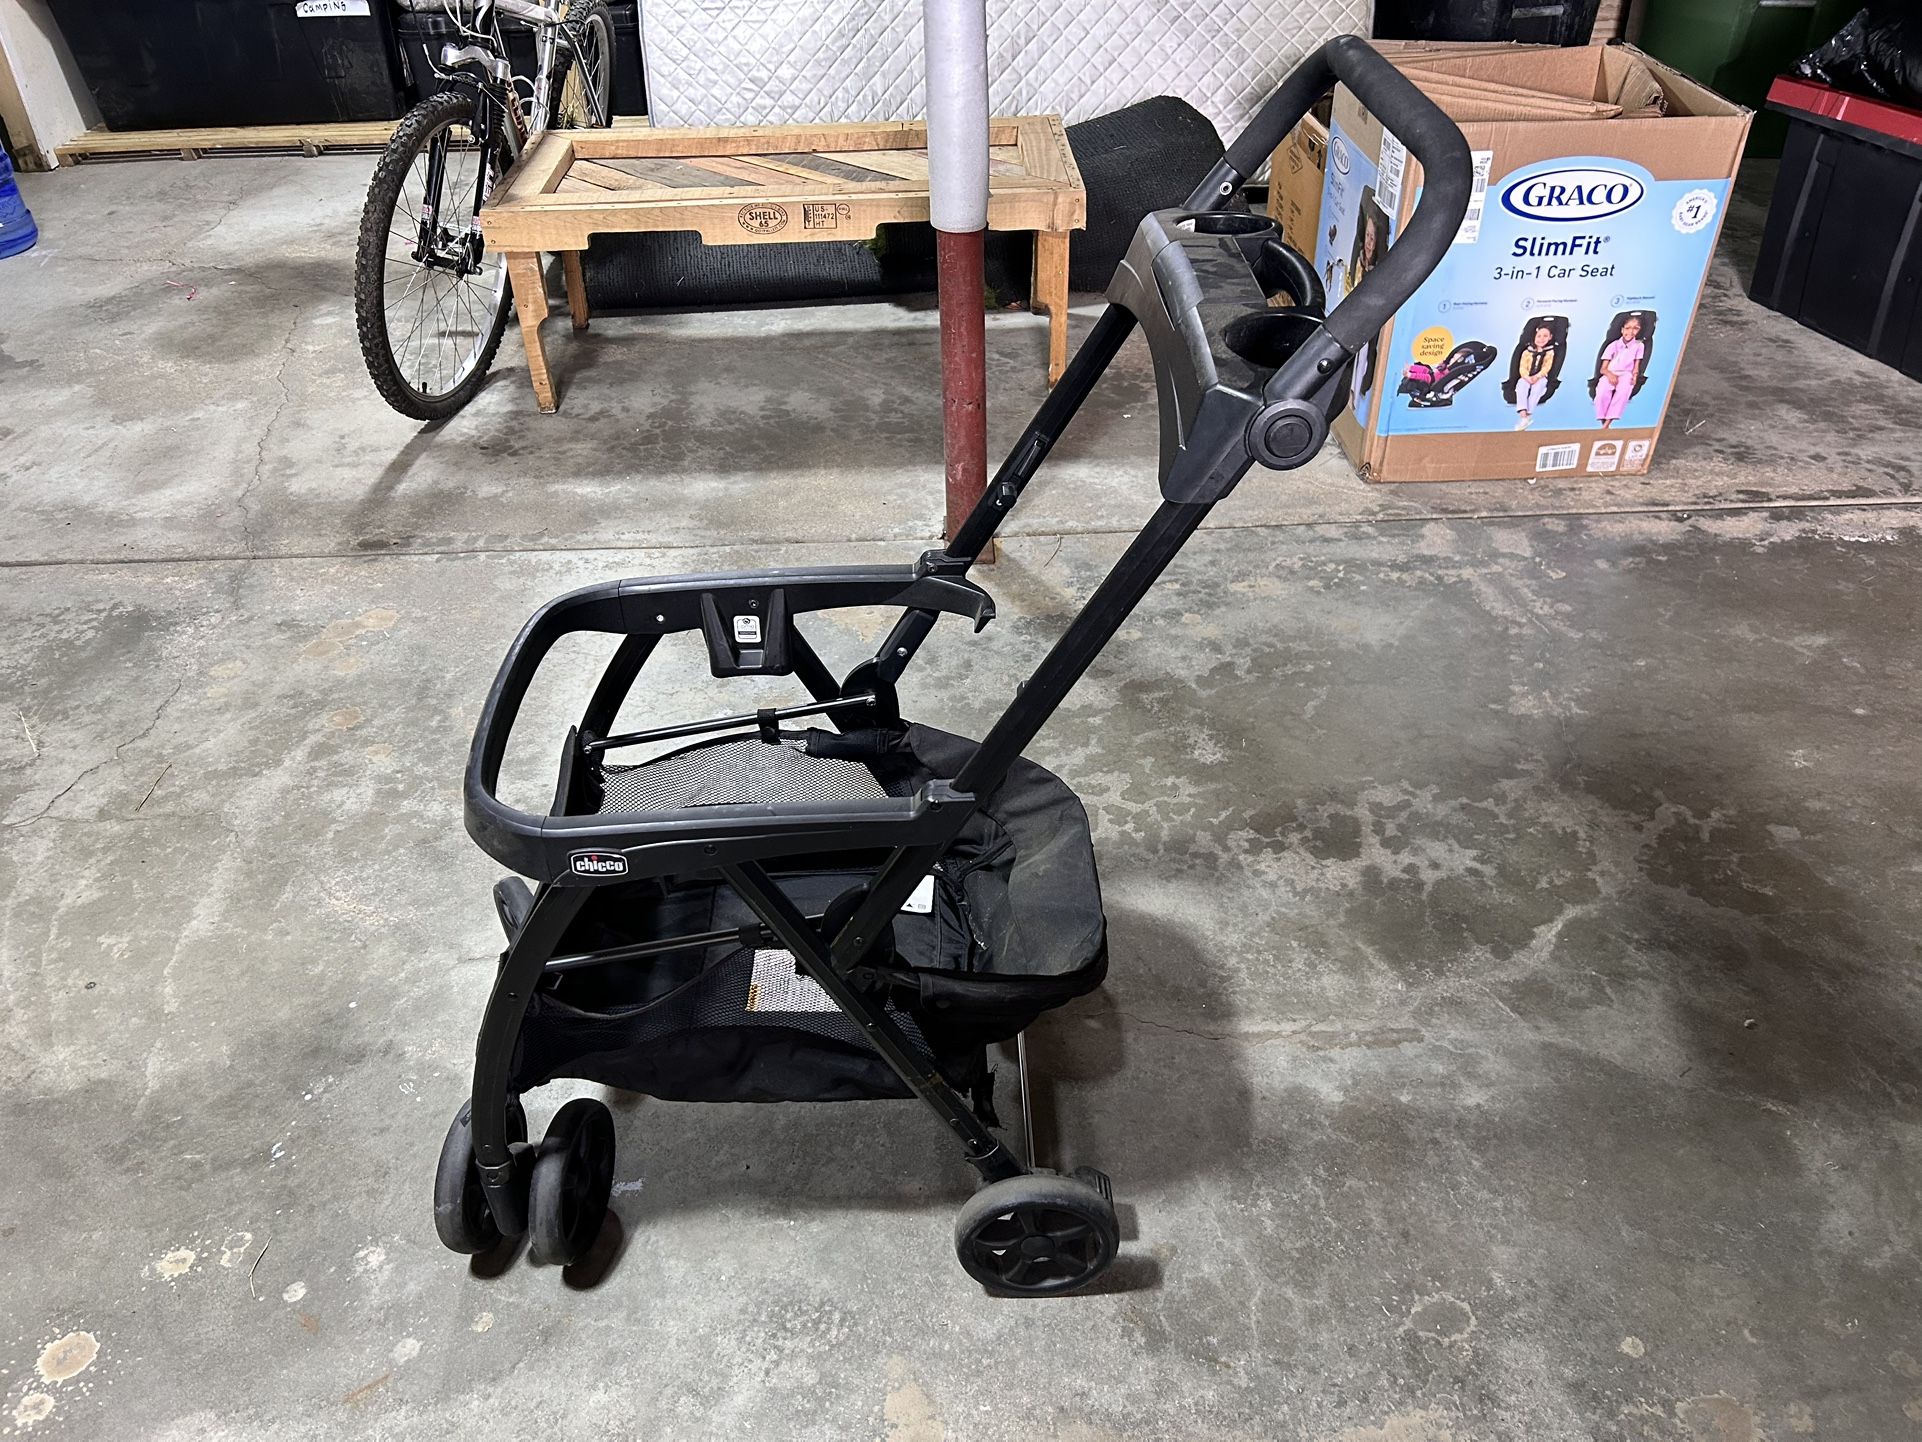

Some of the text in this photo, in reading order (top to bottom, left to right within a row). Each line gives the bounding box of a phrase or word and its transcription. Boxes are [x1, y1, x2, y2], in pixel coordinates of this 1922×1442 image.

[1522, 181, 1629, 208] GRACO
[749, 211, 779, 220] SHELL
[1686, 204, 1702, 219] #1
[759, 220, 770, 228] 65
[1493, 263, 1616, 281] 3-in-1 Car Seat
[1423, 336, 1445, 344] Space
[1419, 349, 1443, 357] design
[576, 855, 624, 872] chicco
